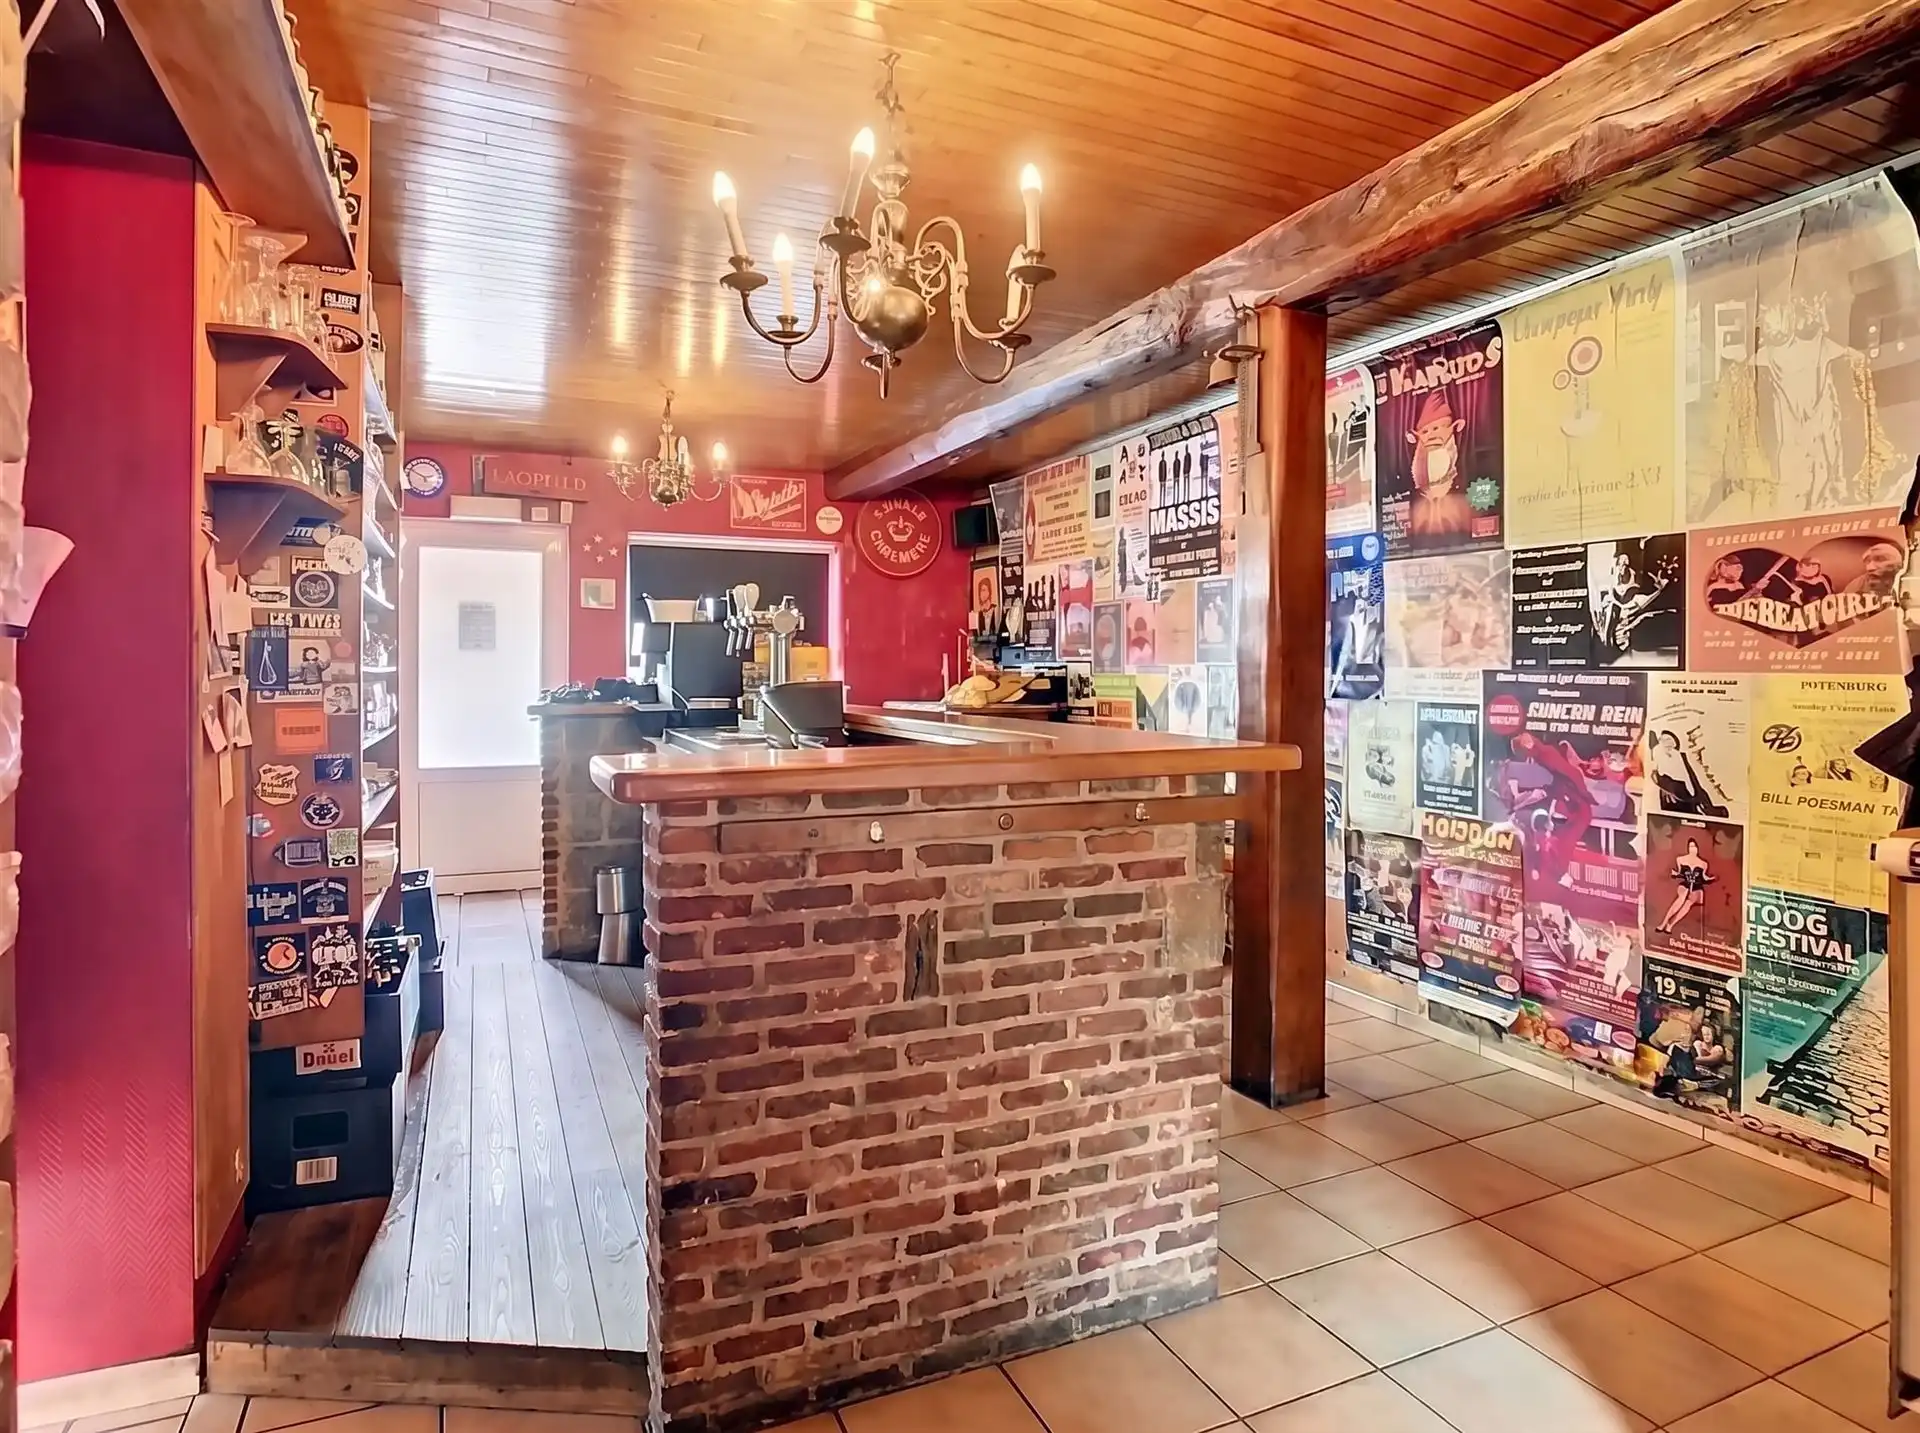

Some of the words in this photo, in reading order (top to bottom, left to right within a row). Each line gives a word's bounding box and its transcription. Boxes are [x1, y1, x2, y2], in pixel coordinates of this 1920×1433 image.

[1150, 497, 1220, 536] MASSIS
[1800, 681, 1888, 692] POTENBURG
[1761, 792, 1793, 805] BILL
[1797, 796, 1876, 814] POESMAN
[1746, 901, 1829, 936] TOOG
[1745, 923, 1860, 965] FESTIVAL
[1654, 975, 1677, 996] 19
